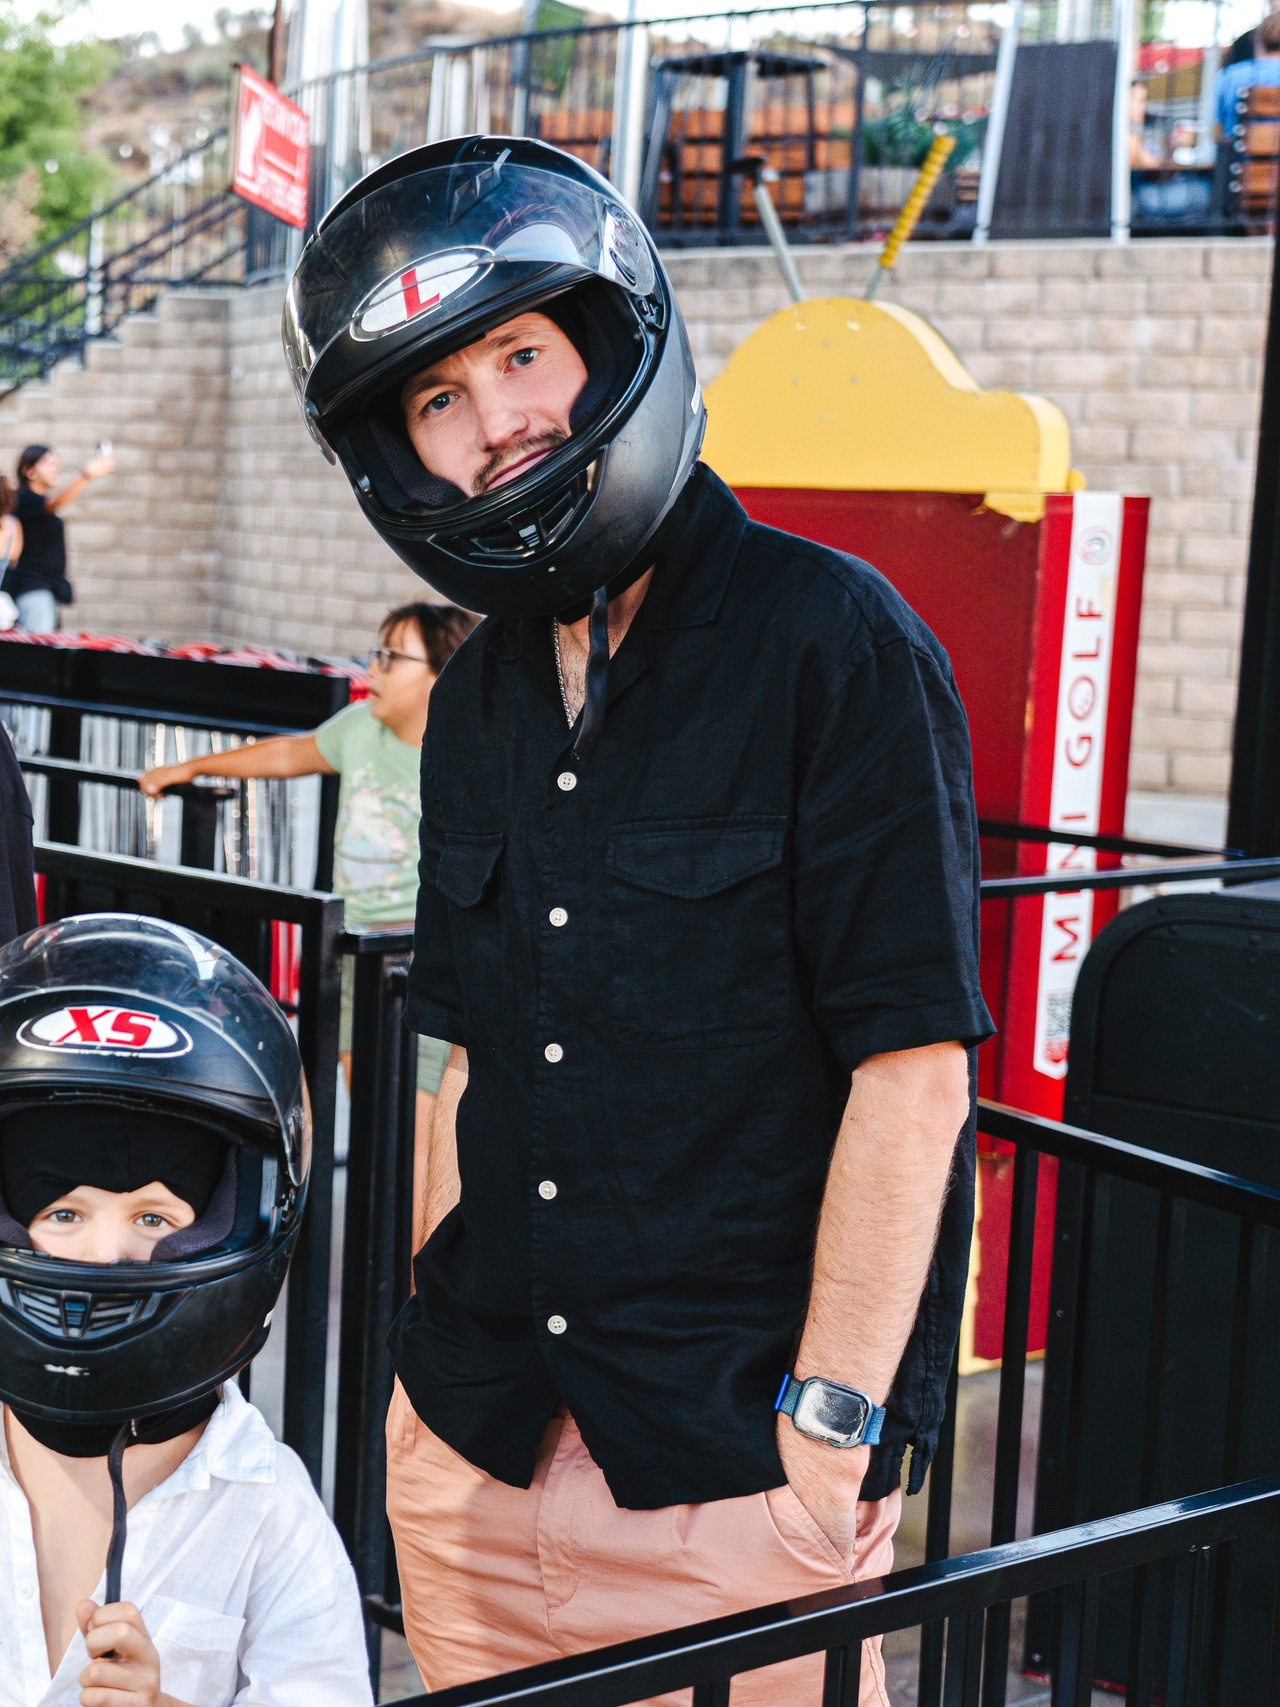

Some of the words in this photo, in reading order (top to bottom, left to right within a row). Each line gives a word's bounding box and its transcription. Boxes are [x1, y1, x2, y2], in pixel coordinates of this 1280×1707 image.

[399, 267, 441, 321] L
[1065, 596, 1104, 769] GOLF
[52, 1007, 158, 1048] XS
